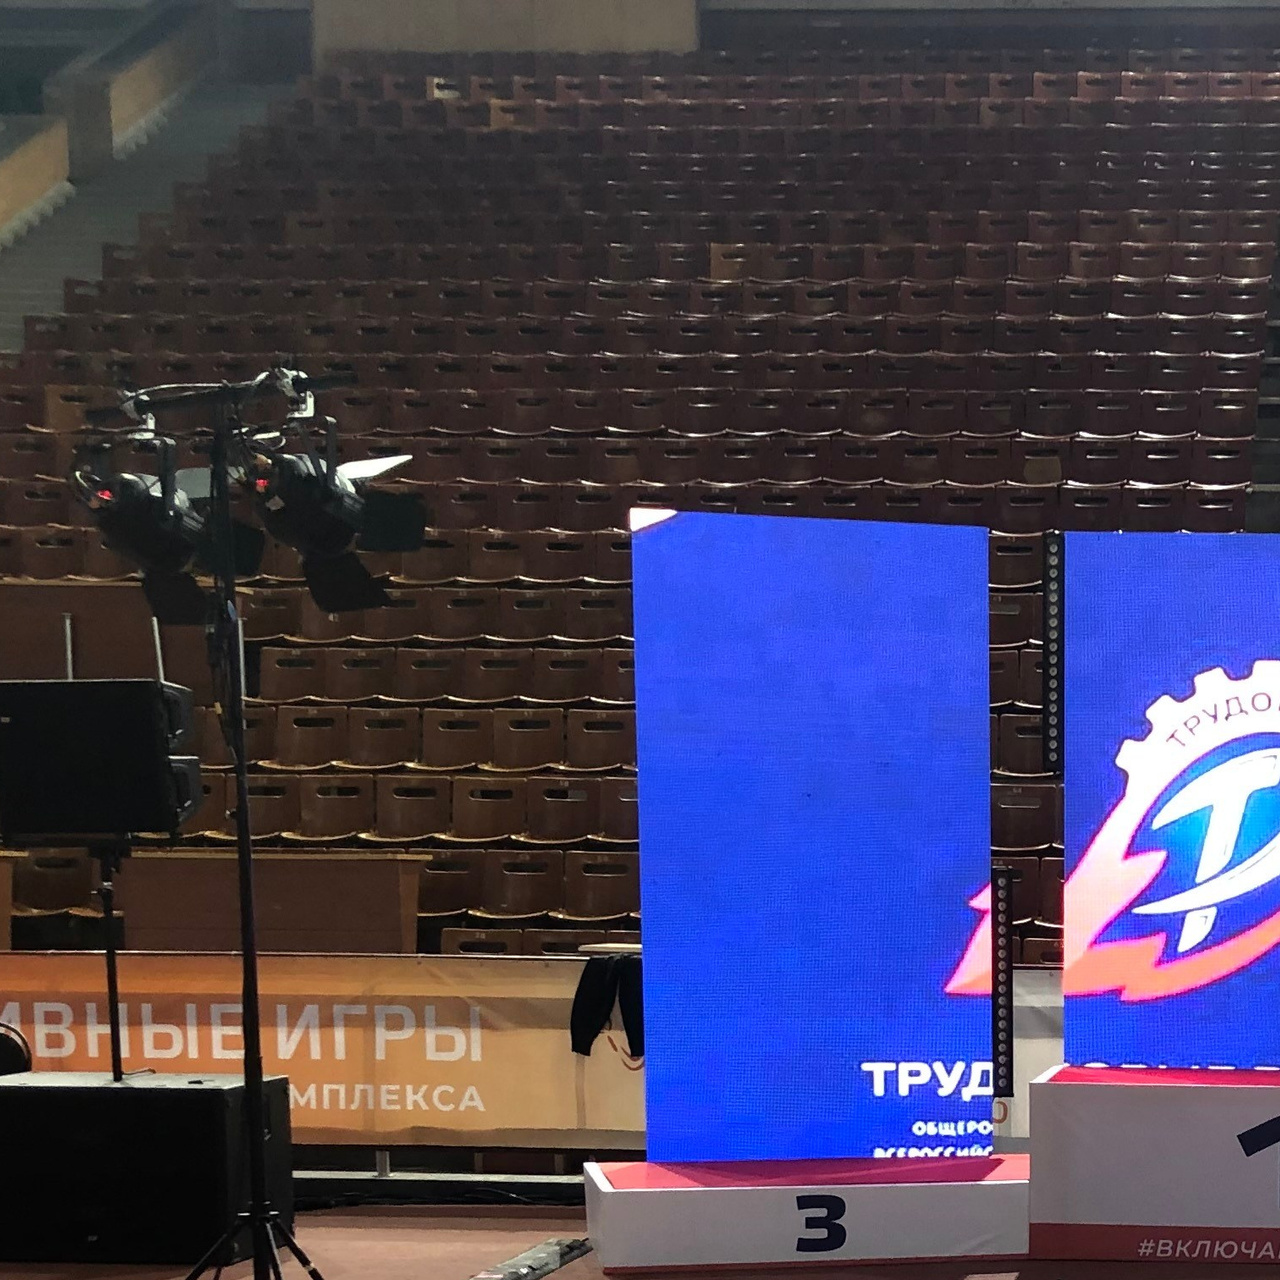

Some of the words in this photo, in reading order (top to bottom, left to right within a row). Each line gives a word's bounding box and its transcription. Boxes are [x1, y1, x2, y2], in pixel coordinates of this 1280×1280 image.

[276, 1003, 482, 1062] ИГРЫ
[288, 1083, 486, 1111] МПЛЕКСА
[860, 1061, 993, 1102] ТРУД
[911, 1121, 993, 1137] ОБЩЕРО
[796, 1194, 847, 1252] 3
